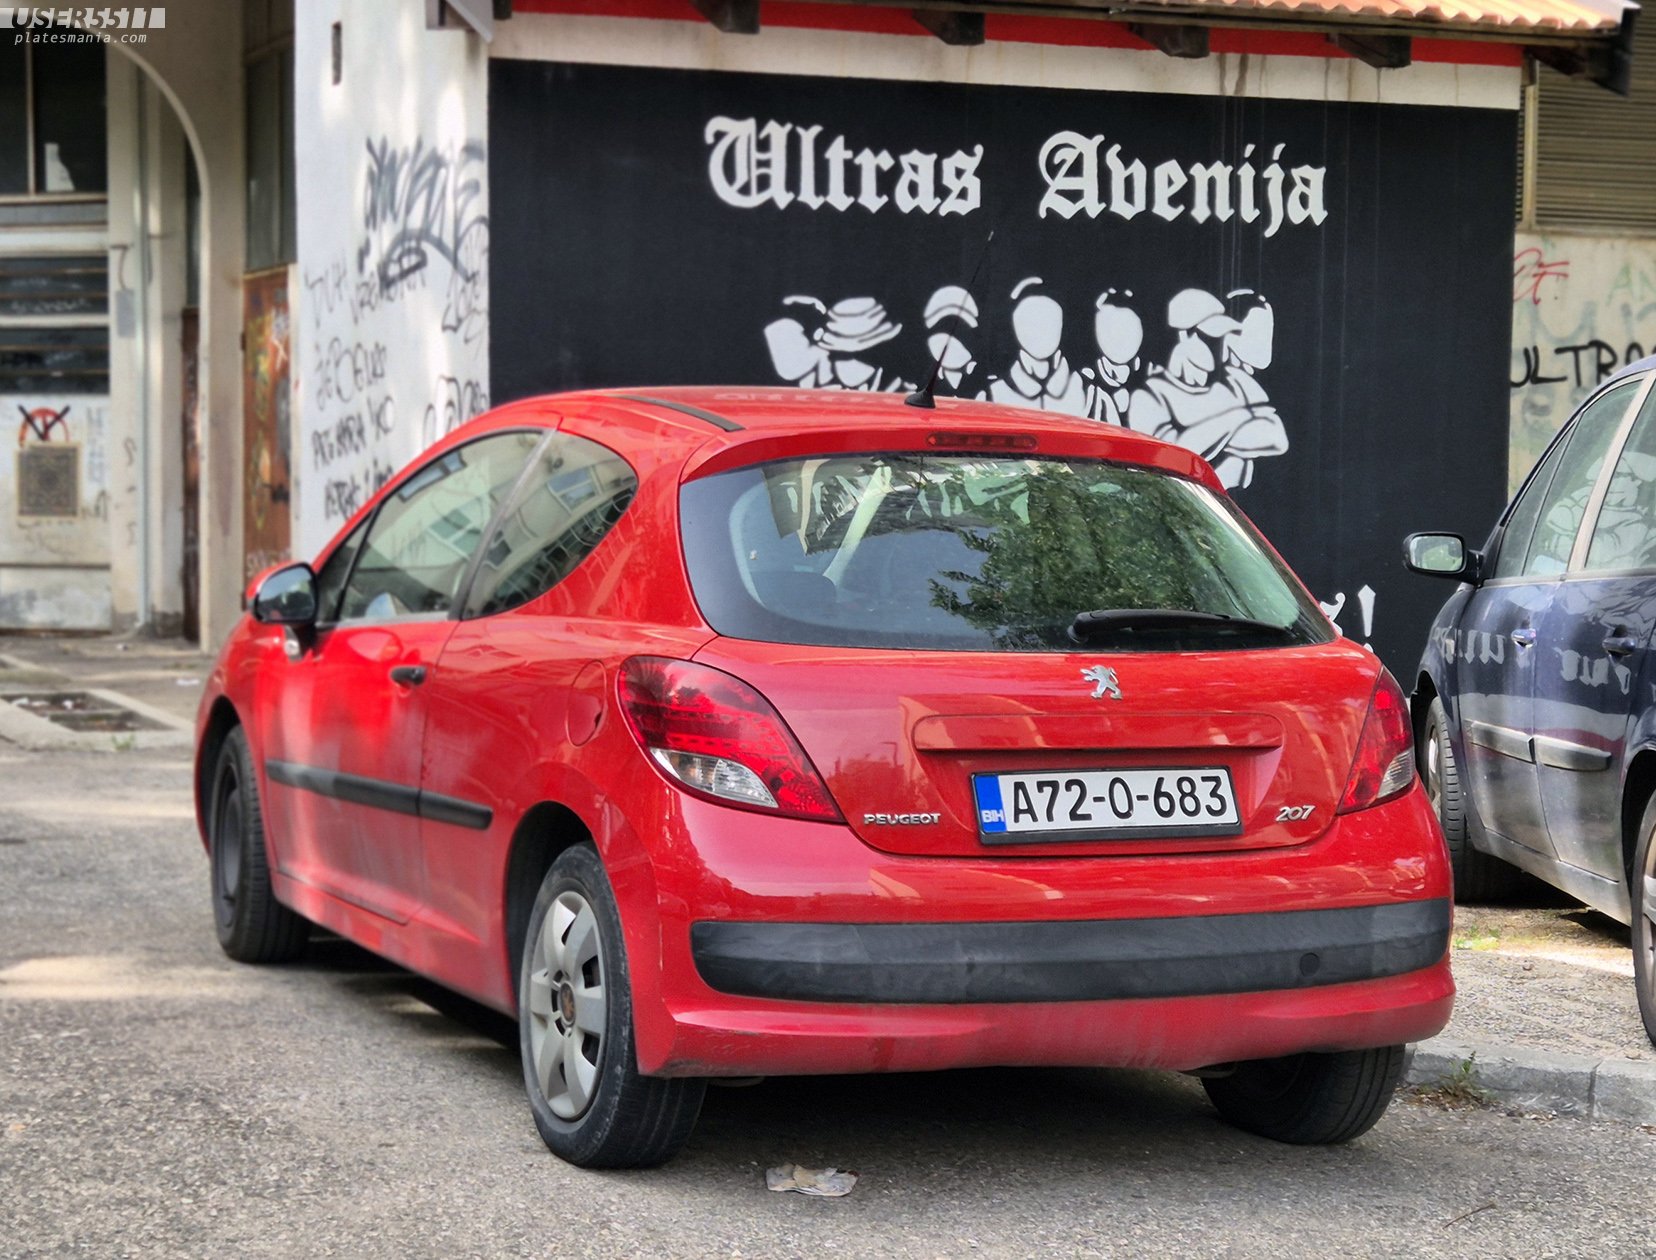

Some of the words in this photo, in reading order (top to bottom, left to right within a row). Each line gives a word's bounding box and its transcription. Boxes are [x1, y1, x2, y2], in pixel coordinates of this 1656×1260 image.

[704, 116, 984, 216] Ultras
[1038, 131, 1328, 238] Avenija
[864, 812, 941, 825] PEUGEOT
[982, 809, 1005, 823] BIH
[1275, 804, 1315, 822] 207
